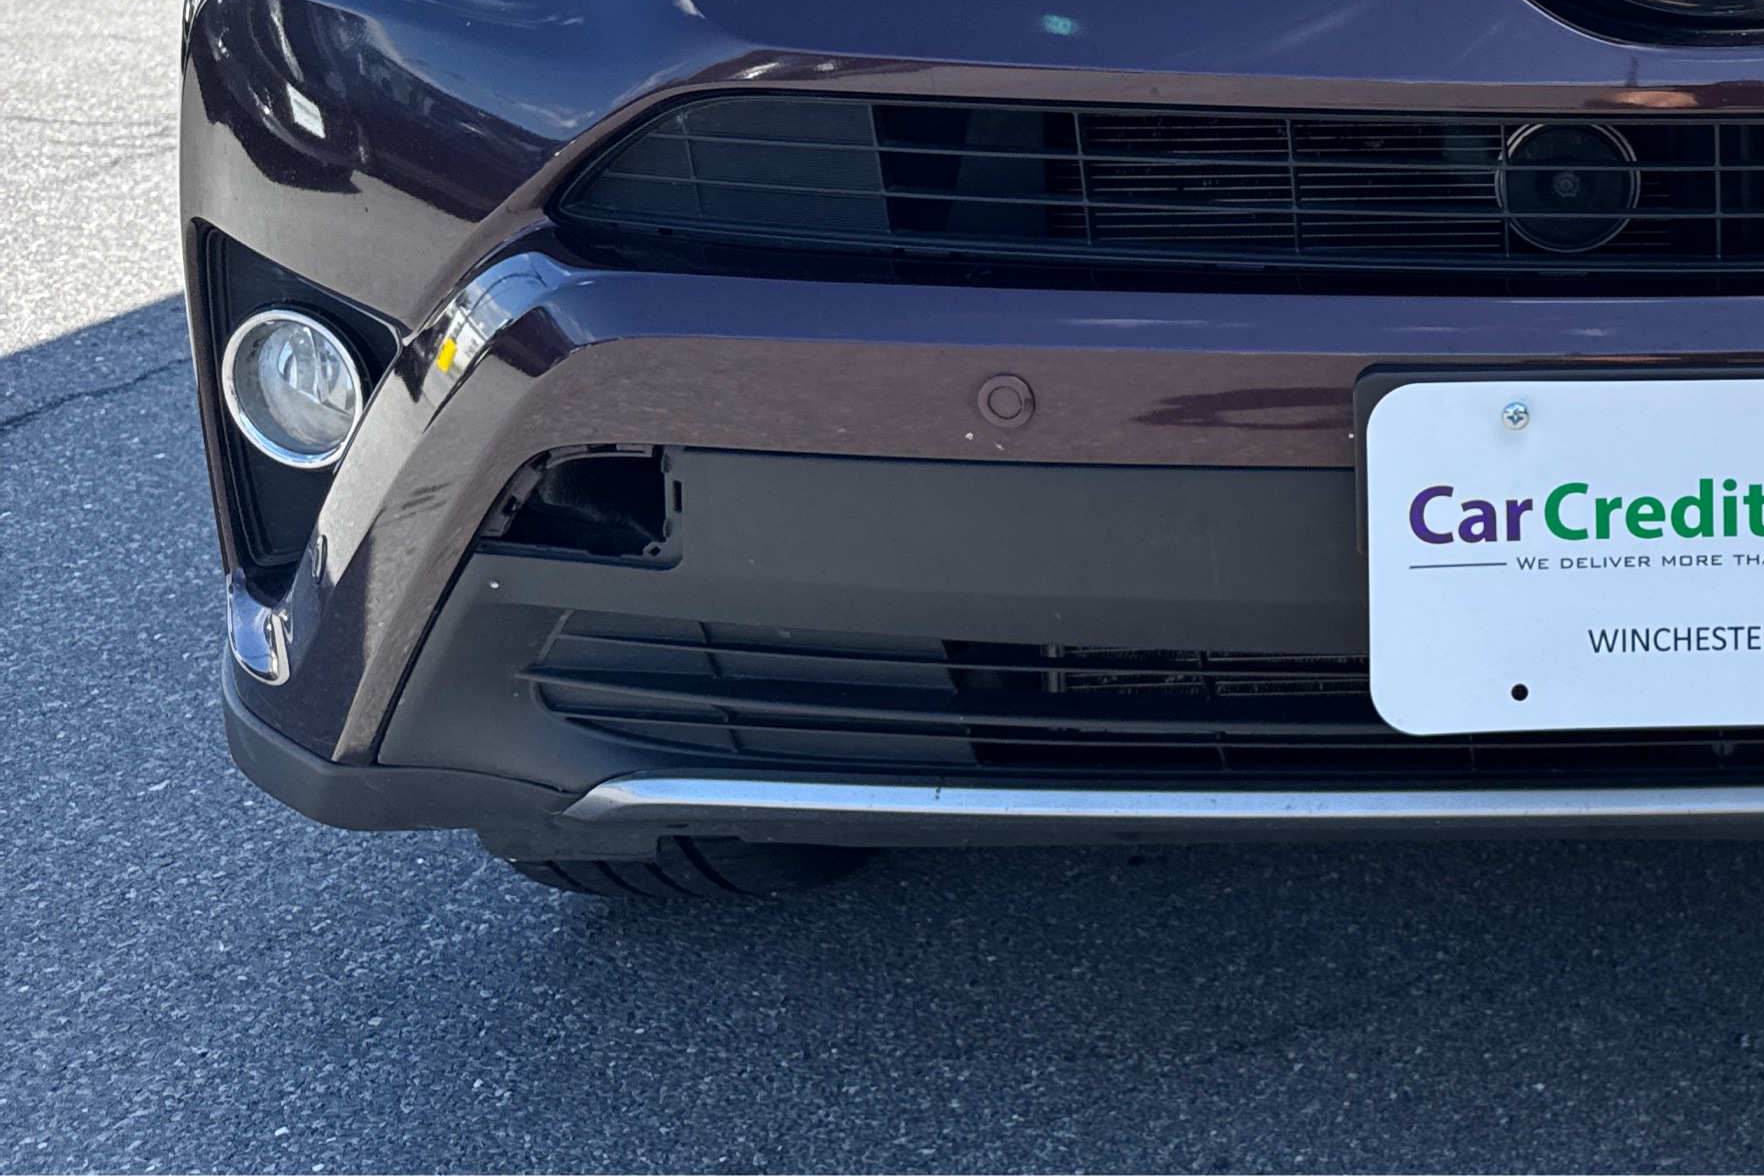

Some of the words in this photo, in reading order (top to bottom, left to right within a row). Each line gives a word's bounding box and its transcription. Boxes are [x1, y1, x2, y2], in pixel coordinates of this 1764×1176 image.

[1409, 485, 1534, 545] Car
[1560, 555, 1651, 570] DELIVER
[1661, 554, 1723, 568] MORE
